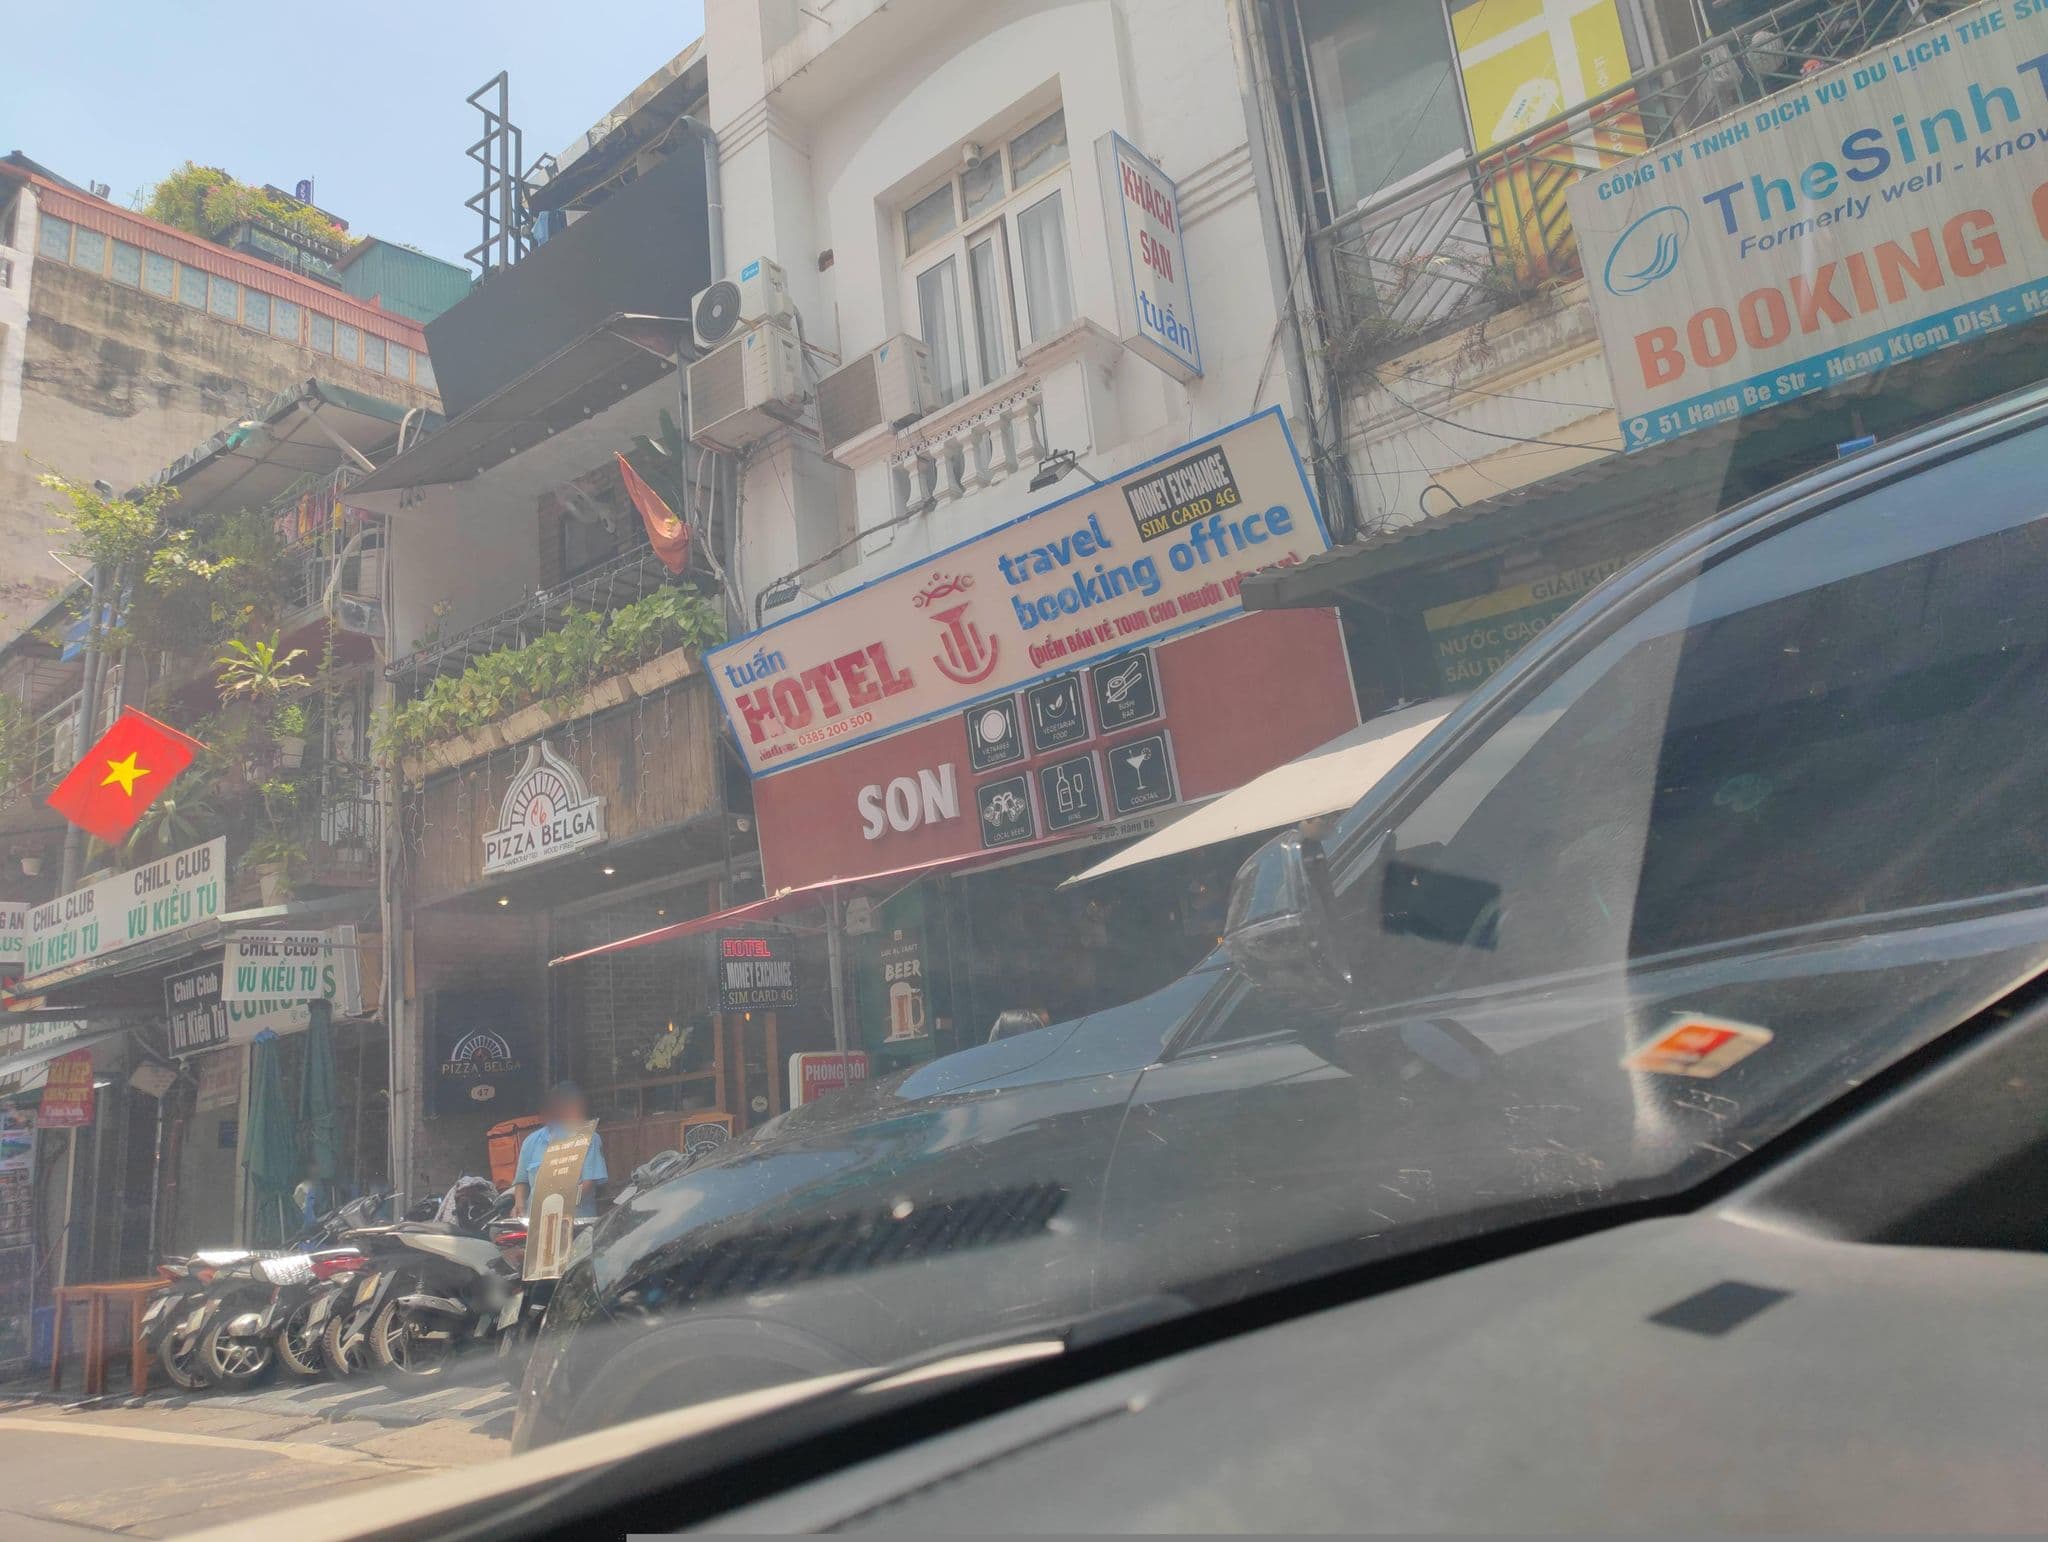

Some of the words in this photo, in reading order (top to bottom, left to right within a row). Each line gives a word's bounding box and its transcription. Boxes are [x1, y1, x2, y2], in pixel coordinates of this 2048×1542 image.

[1598, 164, 1656, 201] CÔNG
[1660, 149, 1685, 174] TY
[1691, 121, 1750, 161] TNHH
[1756, 95, 1811, 133] DỊCH
[1814, 81, 1848, 112] VỤ
[1853, 62, 1887, 91] DU
[1892, 34, 1951, 73] LỊCH
[1955, 10, 2007, 45] THE
[1120, 161, 1176, 235] KHÁCH
[1740, 195, 1871, 259] Formerly
[1882, 162, 1943, 203] well
[1139, 229, 1175, 284] SẠN
[1634, 208, 2007, 390] BOOKING
[1659, 413, 1682, 434] 51
[1687, 392, 1740, 425] Hang
[1743, 384, 1771, 407] Be
[1775, 371, 1807, 396] Str
[1827, 345, 1884, 379] Hoan
[1953, 303, 2002, 338] Dist
[1128, 478, 1172, 522] MONEY
[1166, 453, 1231, 508] EXCHANGE
[1141, 515, 1169, 538] SIM
[1171, 498, 1212, 526] CARD
[1216, 487, 1238, 508] 4G
[998, 512, 1112, 587] travel
[1010, 555, 1162, 632] booking
[1168, 503, 1294, 573] office
[1066, 623, 1096, 652] BÁN
[1095, 617, 1114, 645] VÉ
[1112, 608, 1149, 637] TOUR
[1149, 600, 1178, 626] CHO
[1177, 580, 1224, 615] NGƯỜI
[1439, 626, 1500, 657] NƯỚC
[724, 647, 787, 690] tuấn
[735, 640, 916, 745] HOTEL
[798, 728, 826, 747] 0385
[827, 720, 850, 738] 200
[850, 711, 873, 728] 500
[1043, 718, 1076, 736] VEGETARIAN
[1122, 709, 1136, 720] BAR
[1052, 731, 1068, 742] FOOD
[857, 763, 961, 840] SON
[1130, 791, 1158, 806] COCKTAIL
[486, 831, 536, 863] PIZZA
[541, 810, 596, 847] BELGA
[994, 830, 1011, 842] LOCAL
[1011, 826, 1026, 839] BEER
[134, 861, 172, 896] CHILL
[175, 847, 211, 882] CLUB
[9, 911, 25, 930] AN
[33, 902, 62, 932] CHILL
[65, 889, 95, 921] CLUB
[127, 901, 148, 940] VŨ
[196, 880, 218, 921] TÚ
[81, 916, 99, 954] TÚ
[239, 936, 279, 957] CHILL
[284, 936, 319, 957] CLUB
[723, 938, 772, 958] HOTEL
[174, 977, 196, 1002] Chill
[197, 971, 219, 1001] Club
[237, 961, 257, 993] VŨ
[300, 960, 318, 992] TÚ
[726, 961, 754, 990] MONEY
[755, 960, 793, 987] EXCHANGE
[885, 959, 922, 982] BEER
[728, 991, 749, 1005] SIM
[752, 989, 778, 1003] CARD
[781, 989, 794, 1001] 4G
[442, 1061, 480, 1076] PIZZA
[484, 1059, 521, 1074] BELGA
[805, 1060, 844, 1082] PHÒNG
[477, 1087, 490, 1097] 47
